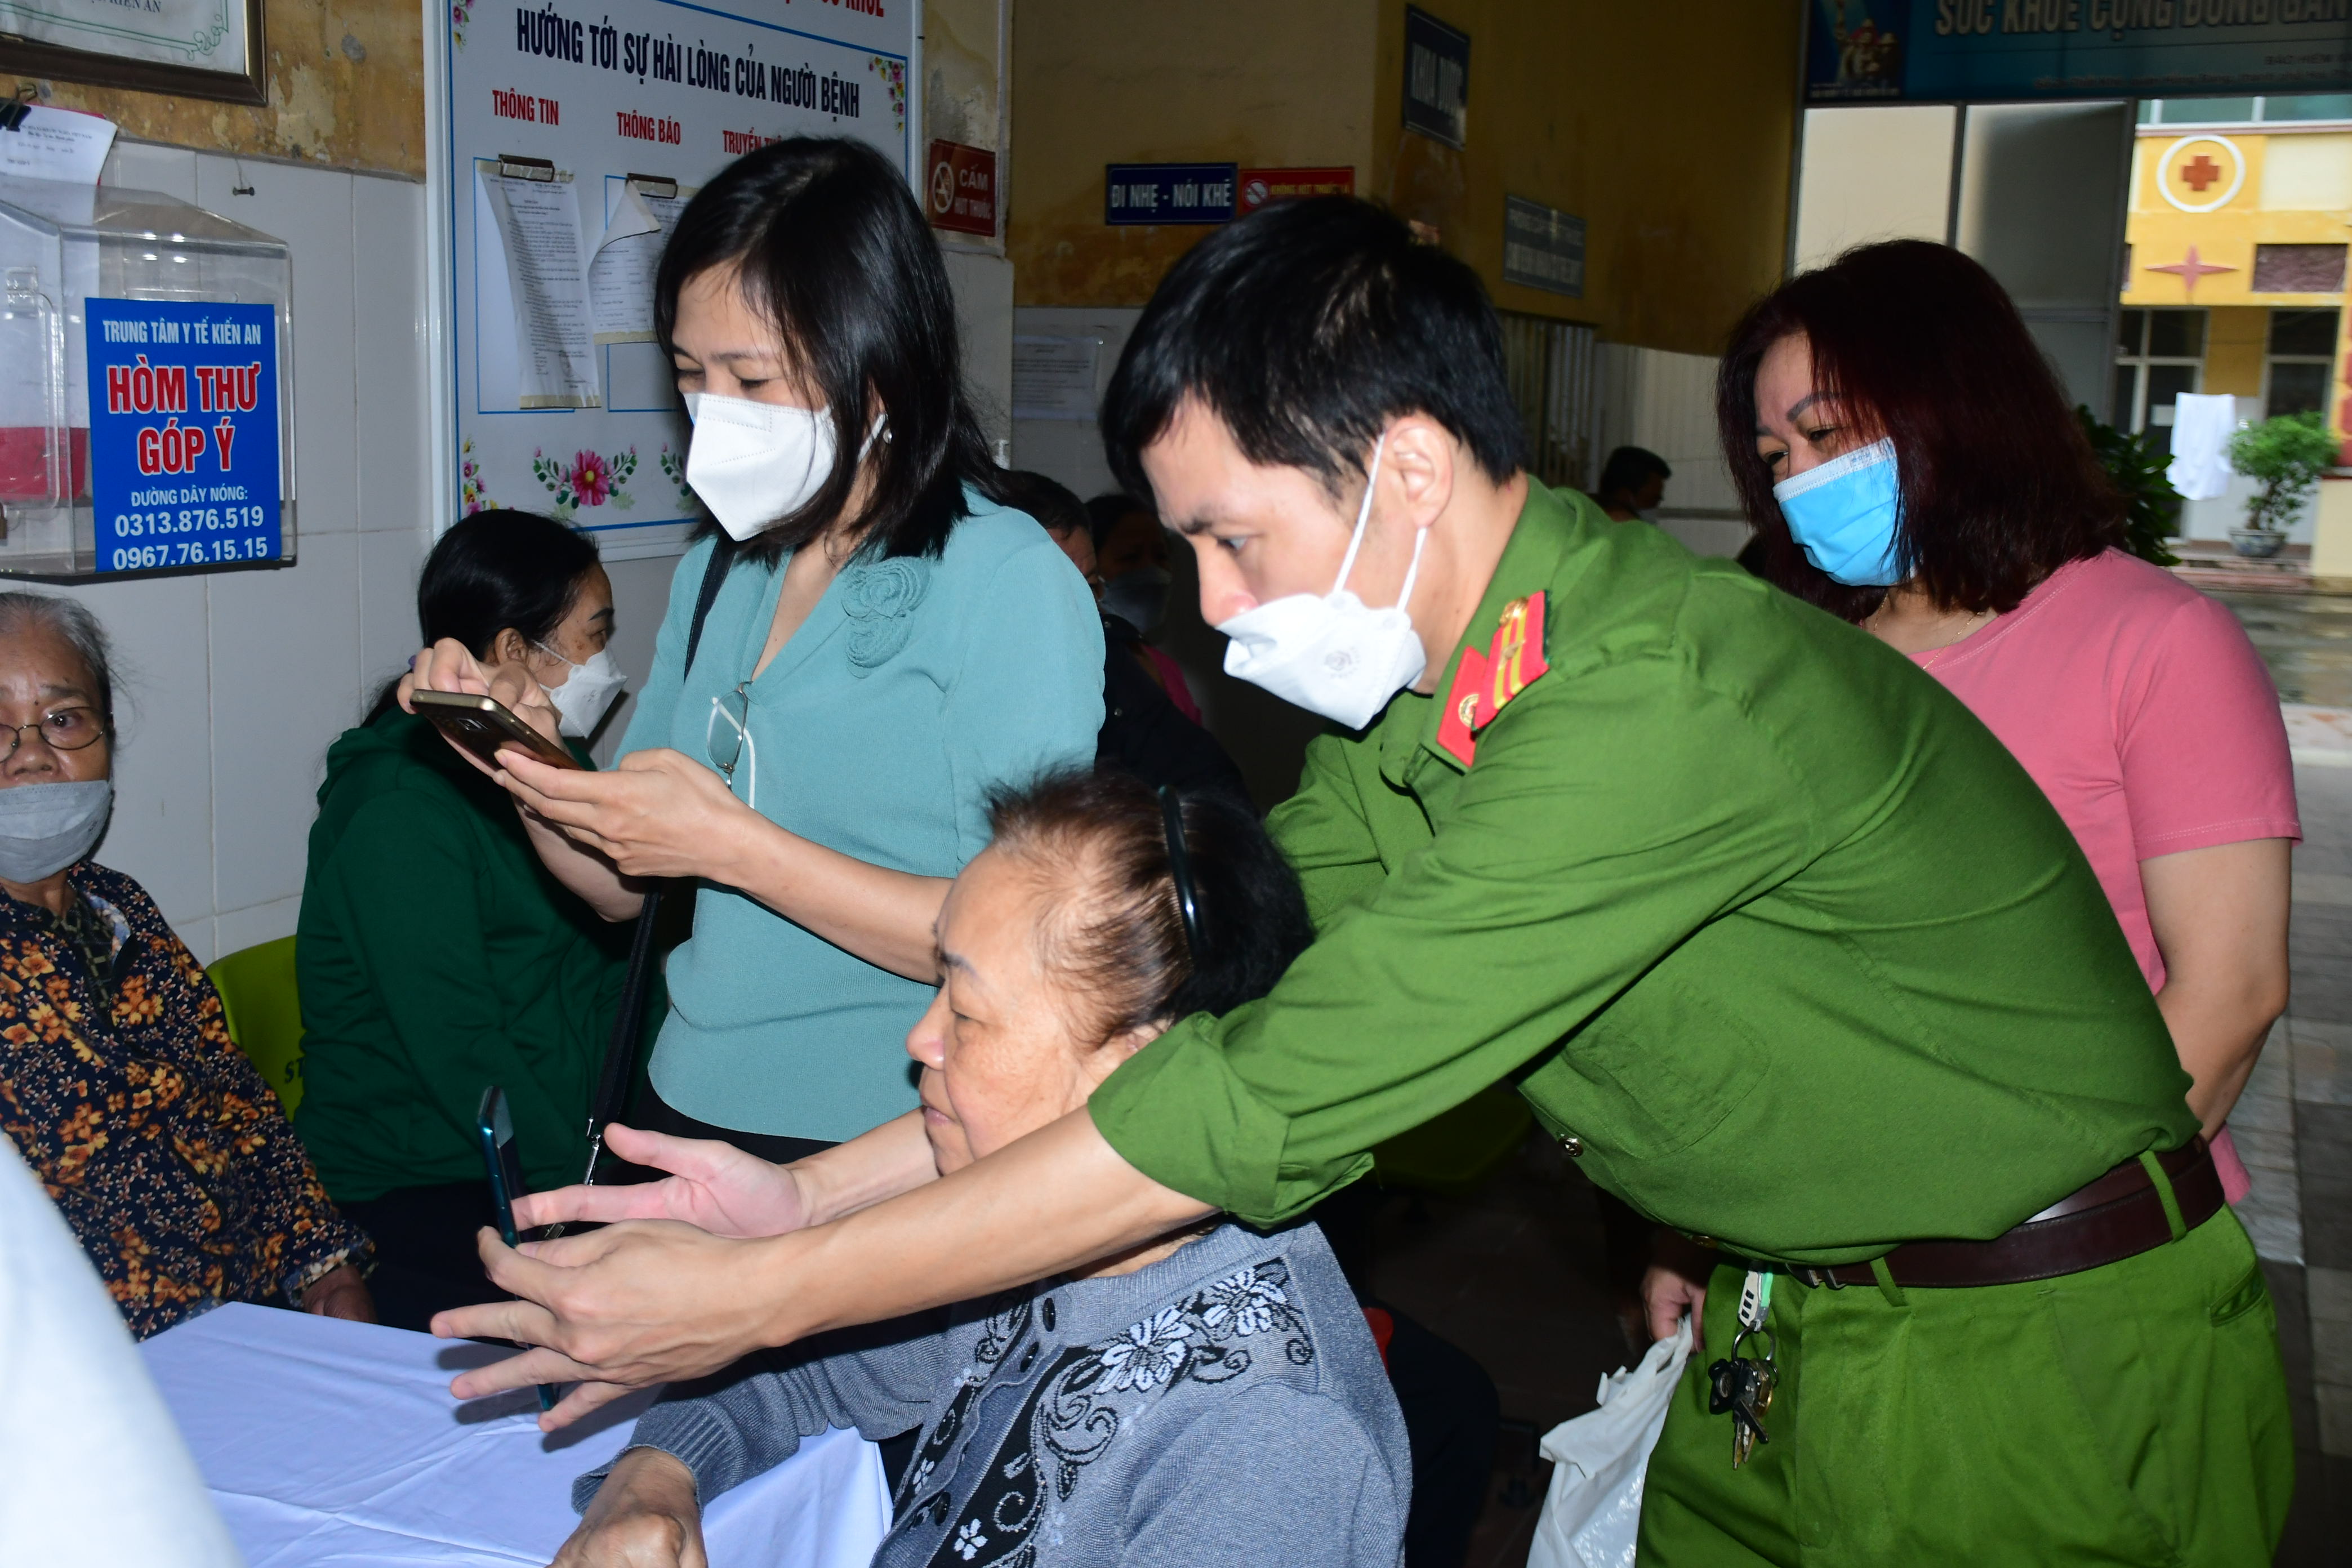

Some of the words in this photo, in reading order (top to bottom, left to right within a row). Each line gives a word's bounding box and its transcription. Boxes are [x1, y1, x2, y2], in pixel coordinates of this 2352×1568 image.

[517, 2, 583, 63] HƯỚNG
[589, 15, 617, 70] TỚI
[623, 33, 649, 84] SỰ
[653, 33, 681, 83] HÀI
[687, 39, 730, 93] LÒNG
[735, 43, 766, 100] CỦA
[770, 62, 816, 110] NGƯỜI
[821, 71, 859, 122] BỆNH
[492, 87, 534, 122] THÔNG
[538, 97, 559, 126] TIN
[616, 109, 654, 141] THÔNG
[658, 115, 681, 145] BÁO
[959, 163, 988, 190] CẤM
[1111, 185, 1126, 207] ĐI
[1130, 184, 1159, 213] NHẸ
[1173, 179, 1199, 207] NÓI
[103, 319, 148, 343] TRUNG
[151, 317, 179, 344] TÂM
[182, 323, 190, 344] Y
[194, 316, 209, 344] TẾ
[212, 317, 240, 344] KIẾN
[244, 324, 261, 345] AN
[106, 354, 188, 414] HÒM
[195, 362, 261, 412] THƯ
[137, 417, 206, 475] GÓP
[213, 416, 235, 471] Ý
[131, 486, 177, 507] ĐƯỜNG
[181, 484, 207, 504] DÂY
[210, 483, 248, 501] NÓNG:
[115, 506, 264, 537] 0313.876.519
[113, 537, 268, 570] 0967.76.15.15
